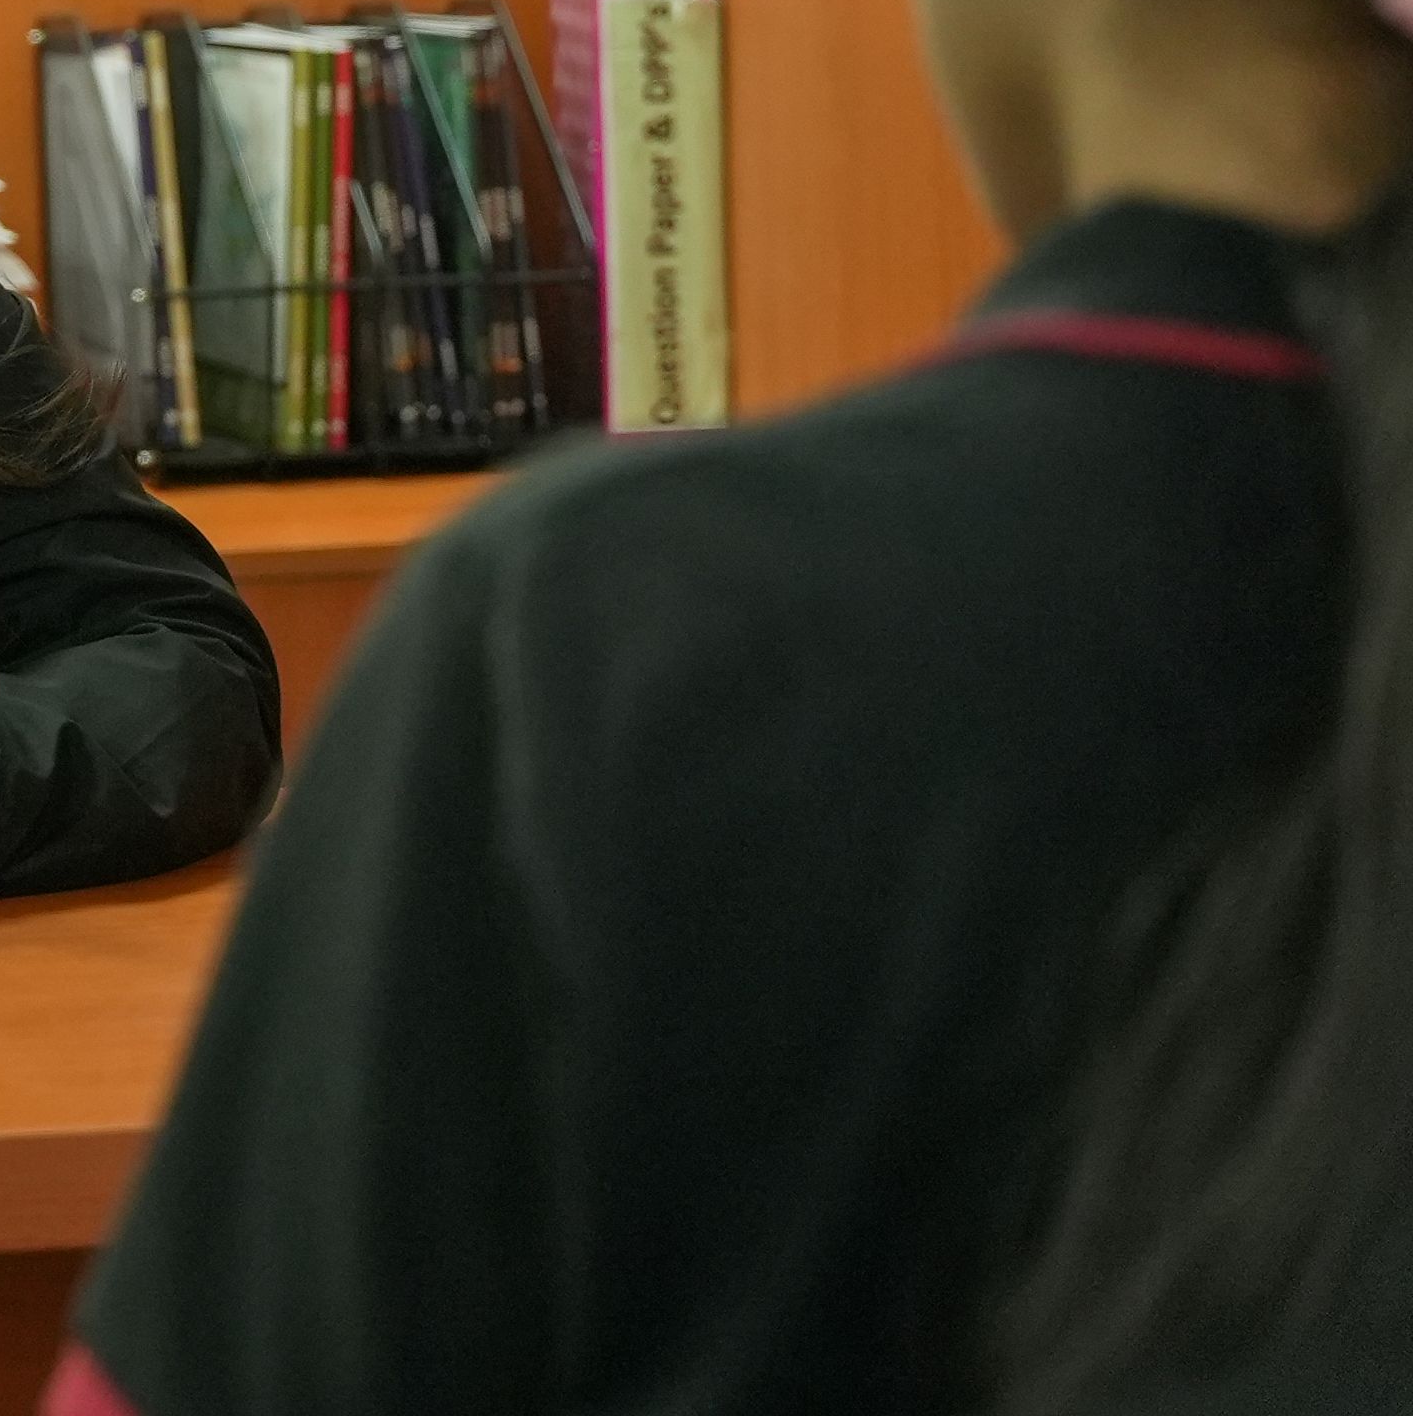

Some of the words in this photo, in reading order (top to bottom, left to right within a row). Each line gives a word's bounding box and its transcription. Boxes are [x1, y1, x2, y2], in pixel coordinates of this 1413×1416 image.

[642, 114, 674, 144] &
[645, 157, 681, 258] Paper
[650, 267, 681, 425] Question
